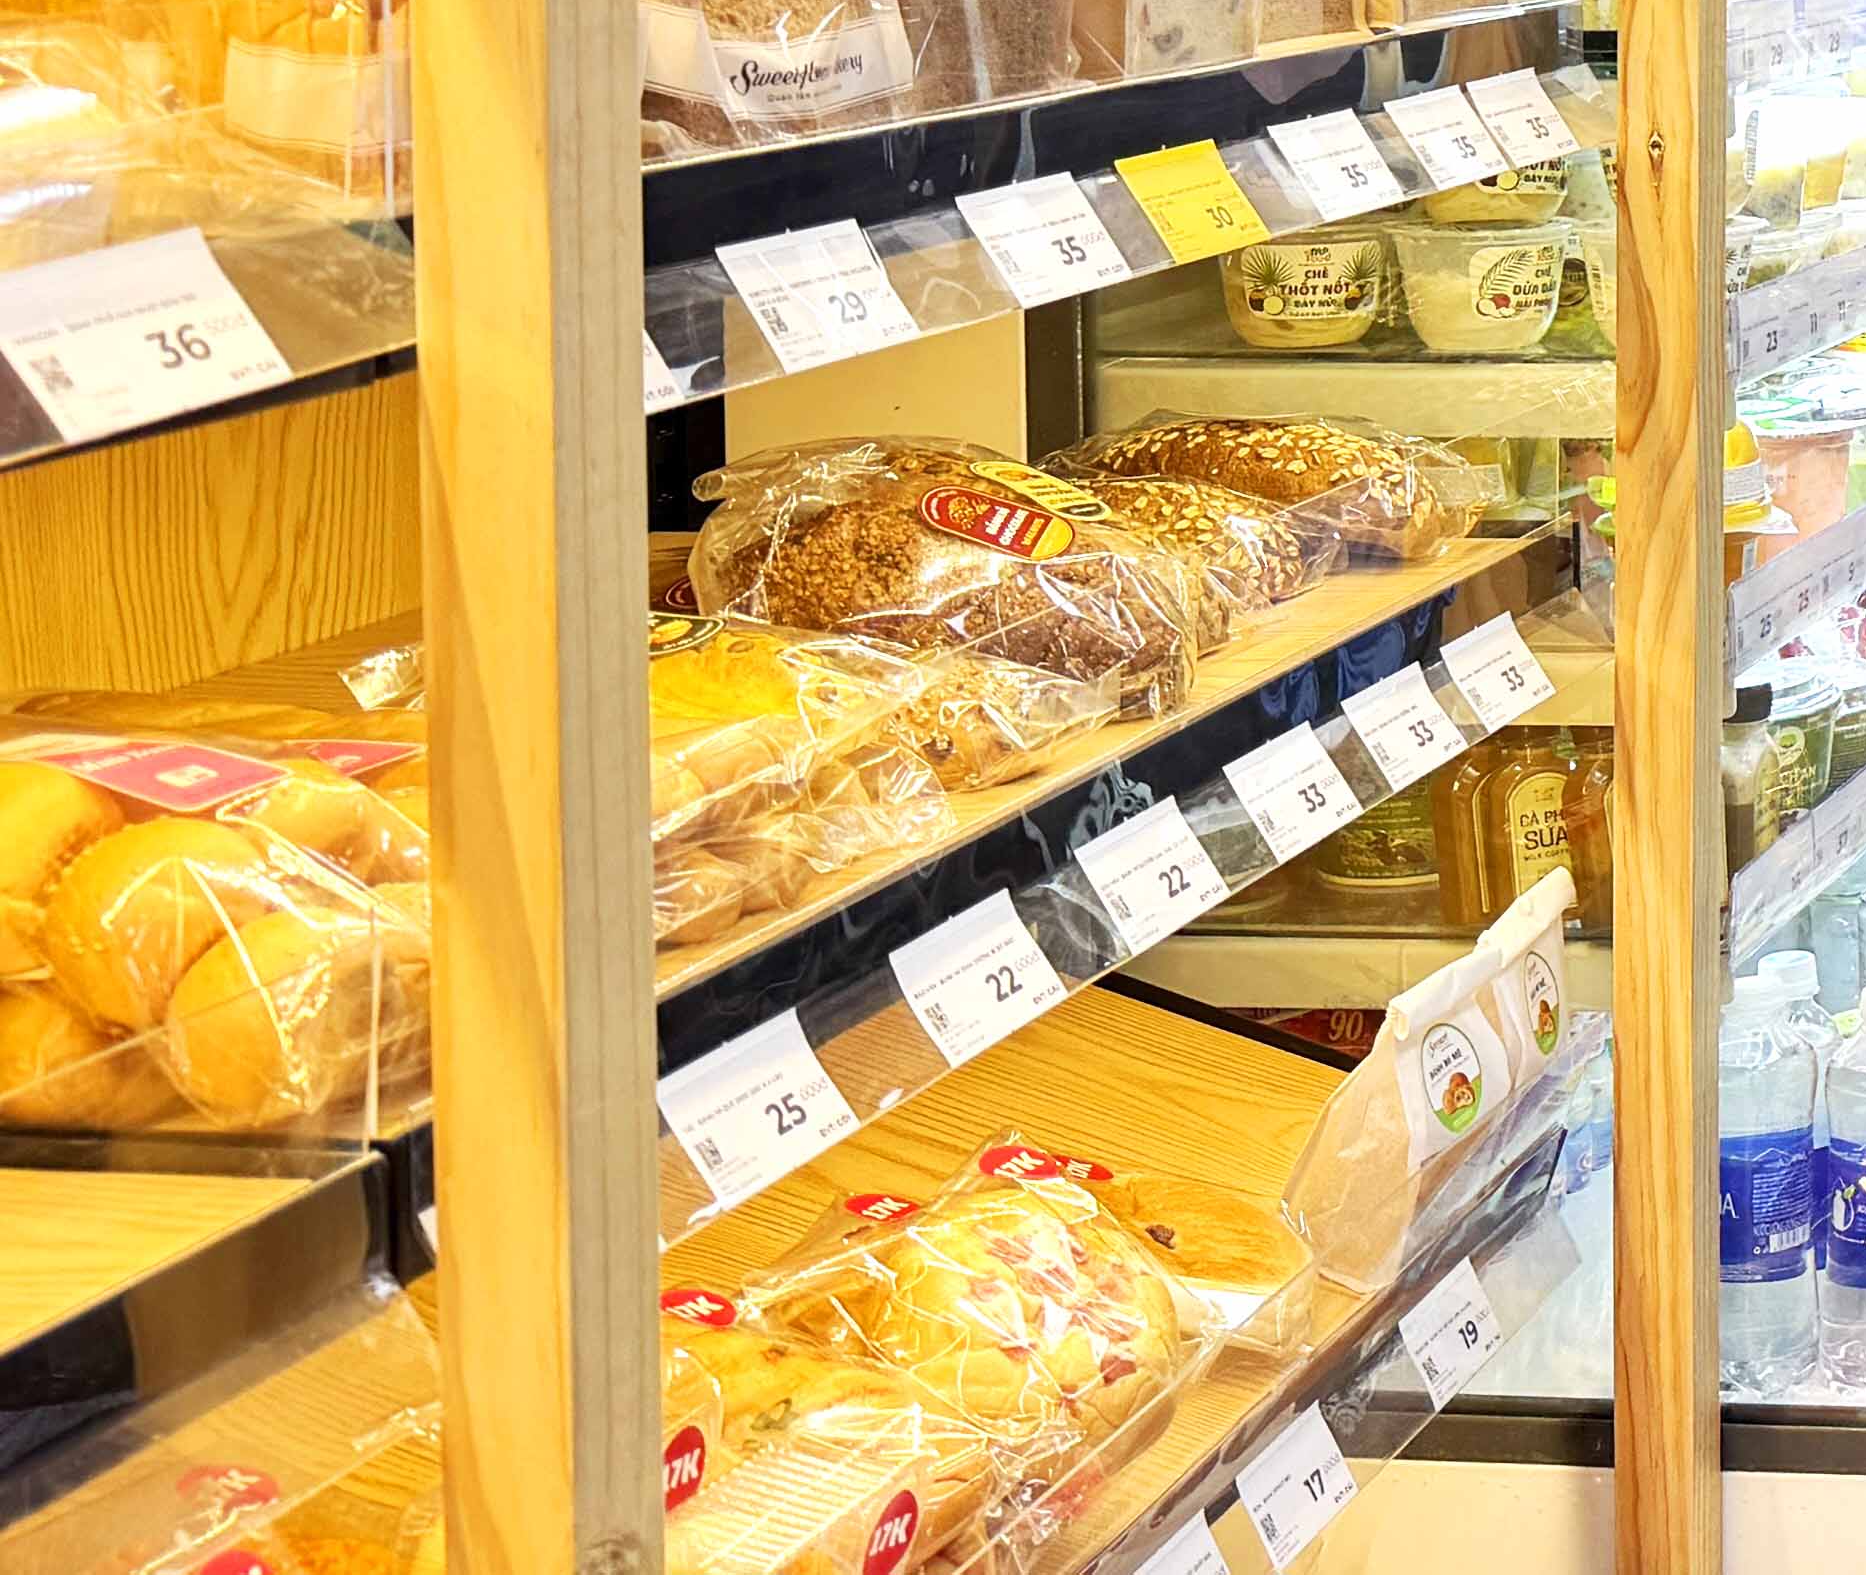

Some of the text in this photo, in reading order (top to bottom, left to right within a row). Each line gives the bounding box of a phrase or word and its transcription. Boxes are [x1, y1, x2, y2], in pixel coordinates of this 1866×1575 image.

[1526, 117, 1550, 140] 35
[1451, 137, 1478, 160] 35
[1340, 163, 1369, 189] 35
[1206, 205, 1234, 229] 30
[1051, 237, 1087, 266] 35
[828, 291, 868, 324] 29
[145, 321, 212, 371] 36
[1501, 664, 1526, 692] 33
[1408, 719, 1435, 747] 33
[1297, 782, 1327, 814] 33
[1158, 864, 1192, 898] 22
[985, 965, 1023, 1003] 22
[765, 1093, 807, 1136] 25
[1458, 1320, 1478, 1350] 19
[1303, 1469, 1326, 1502] 17
[867, 1511, 914, 1558] 17K
